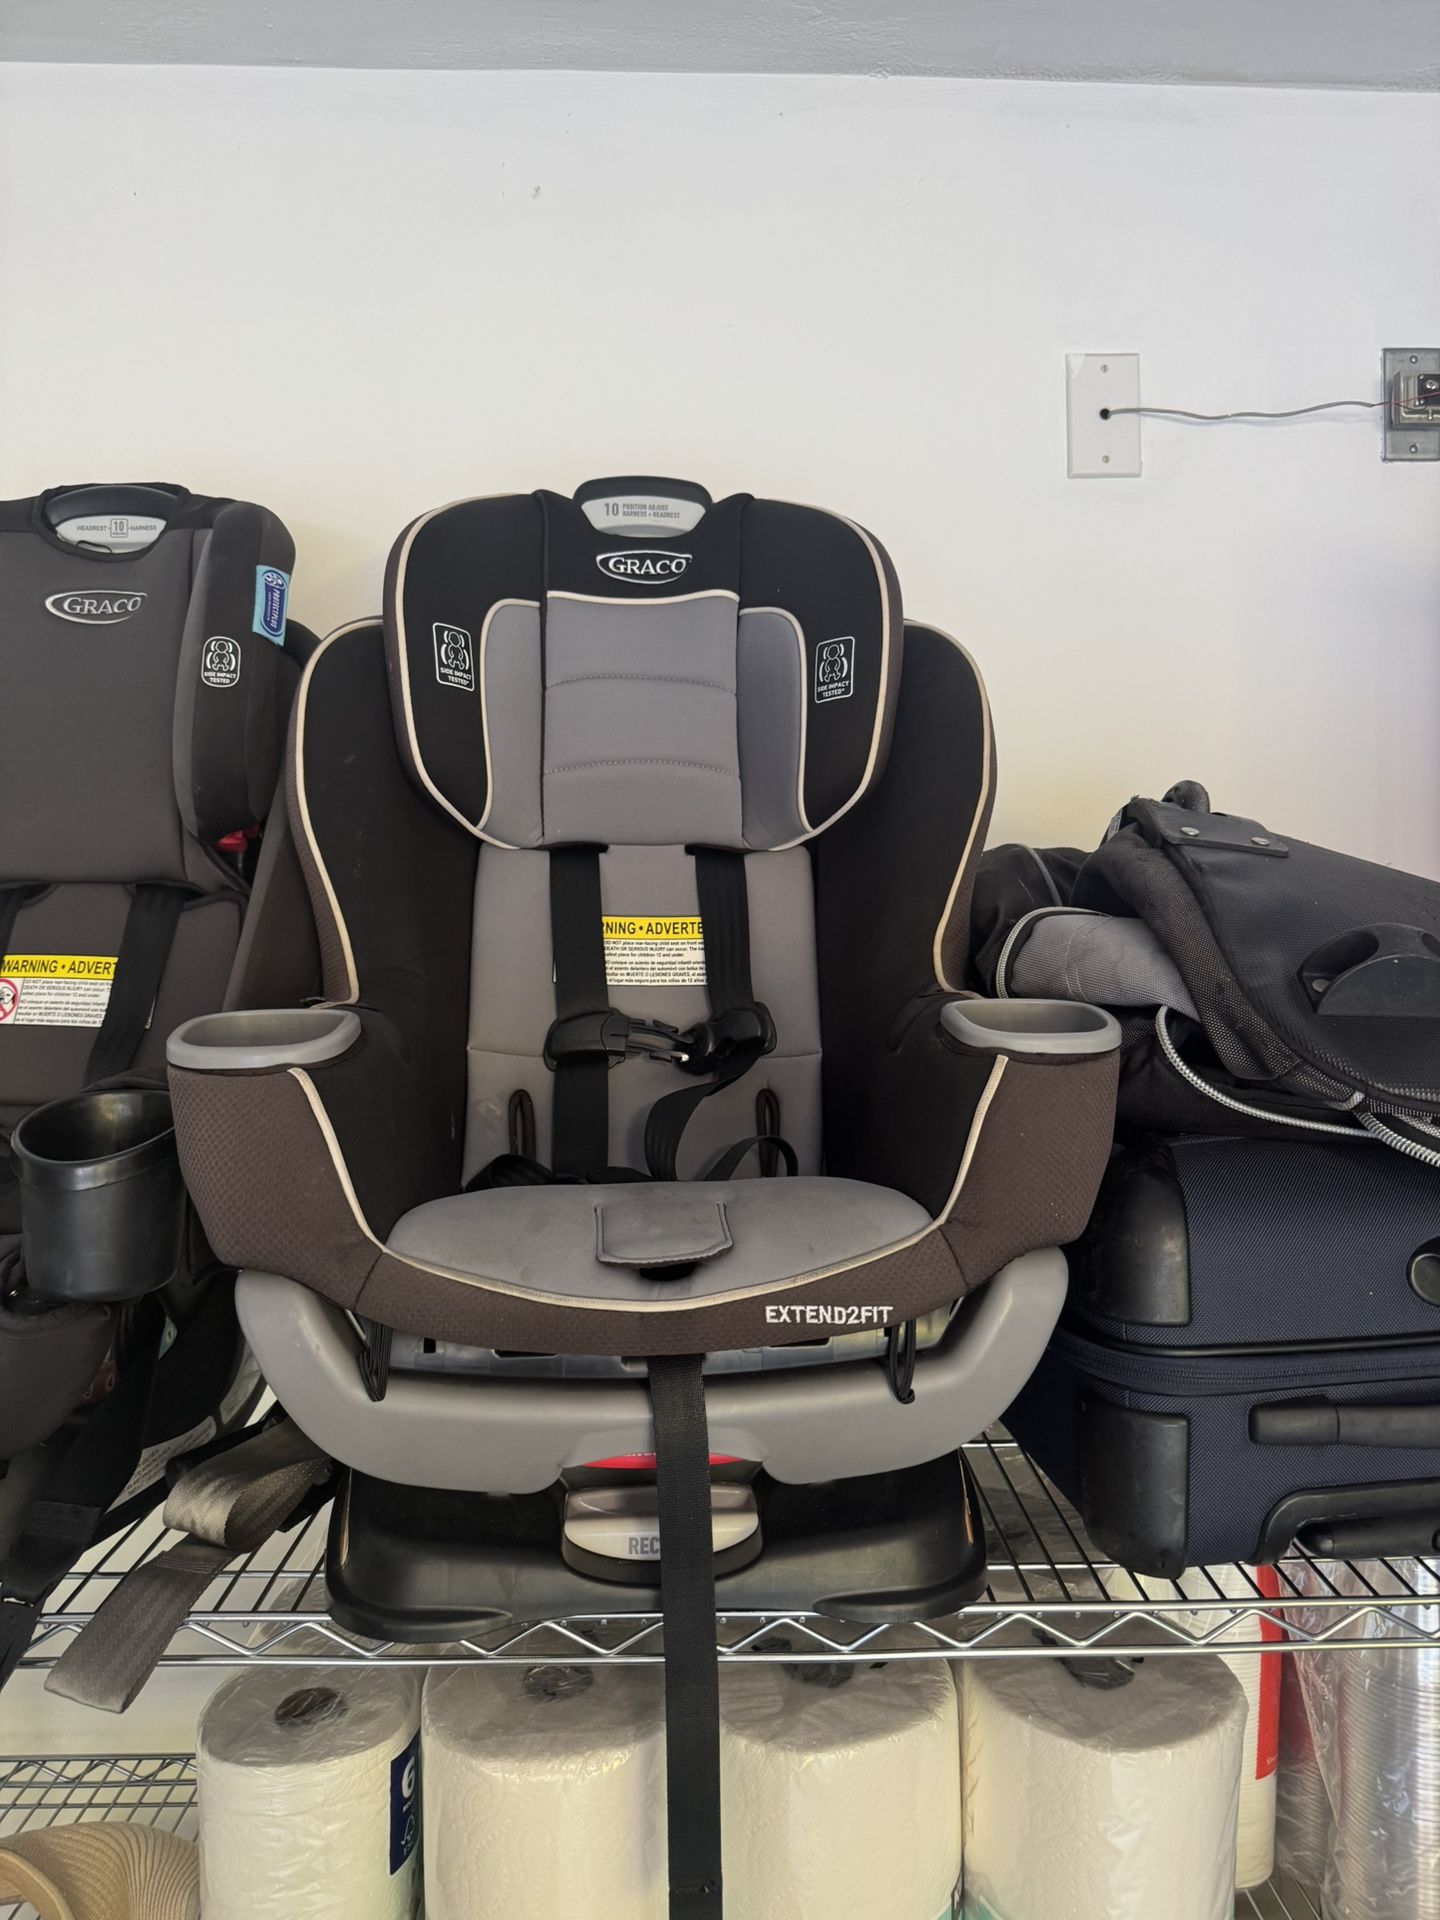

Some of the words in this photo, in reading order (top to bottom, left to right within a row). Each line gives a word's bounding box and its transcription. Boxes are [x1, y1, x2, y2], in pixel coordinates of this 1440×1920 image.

[603, 503, 619, 516] 10
[114, 521, 125, 531] 10
[608, 557, 687, 574] GRACO
[63, 597, 142, 614] GRACO
[602, 922, 636, 934] NING
[2, 960, 58, 973] WARNING
[765, 1305, 893, 1325] EXTEND2FIT
[628, 1536, 660, 1554] REC
